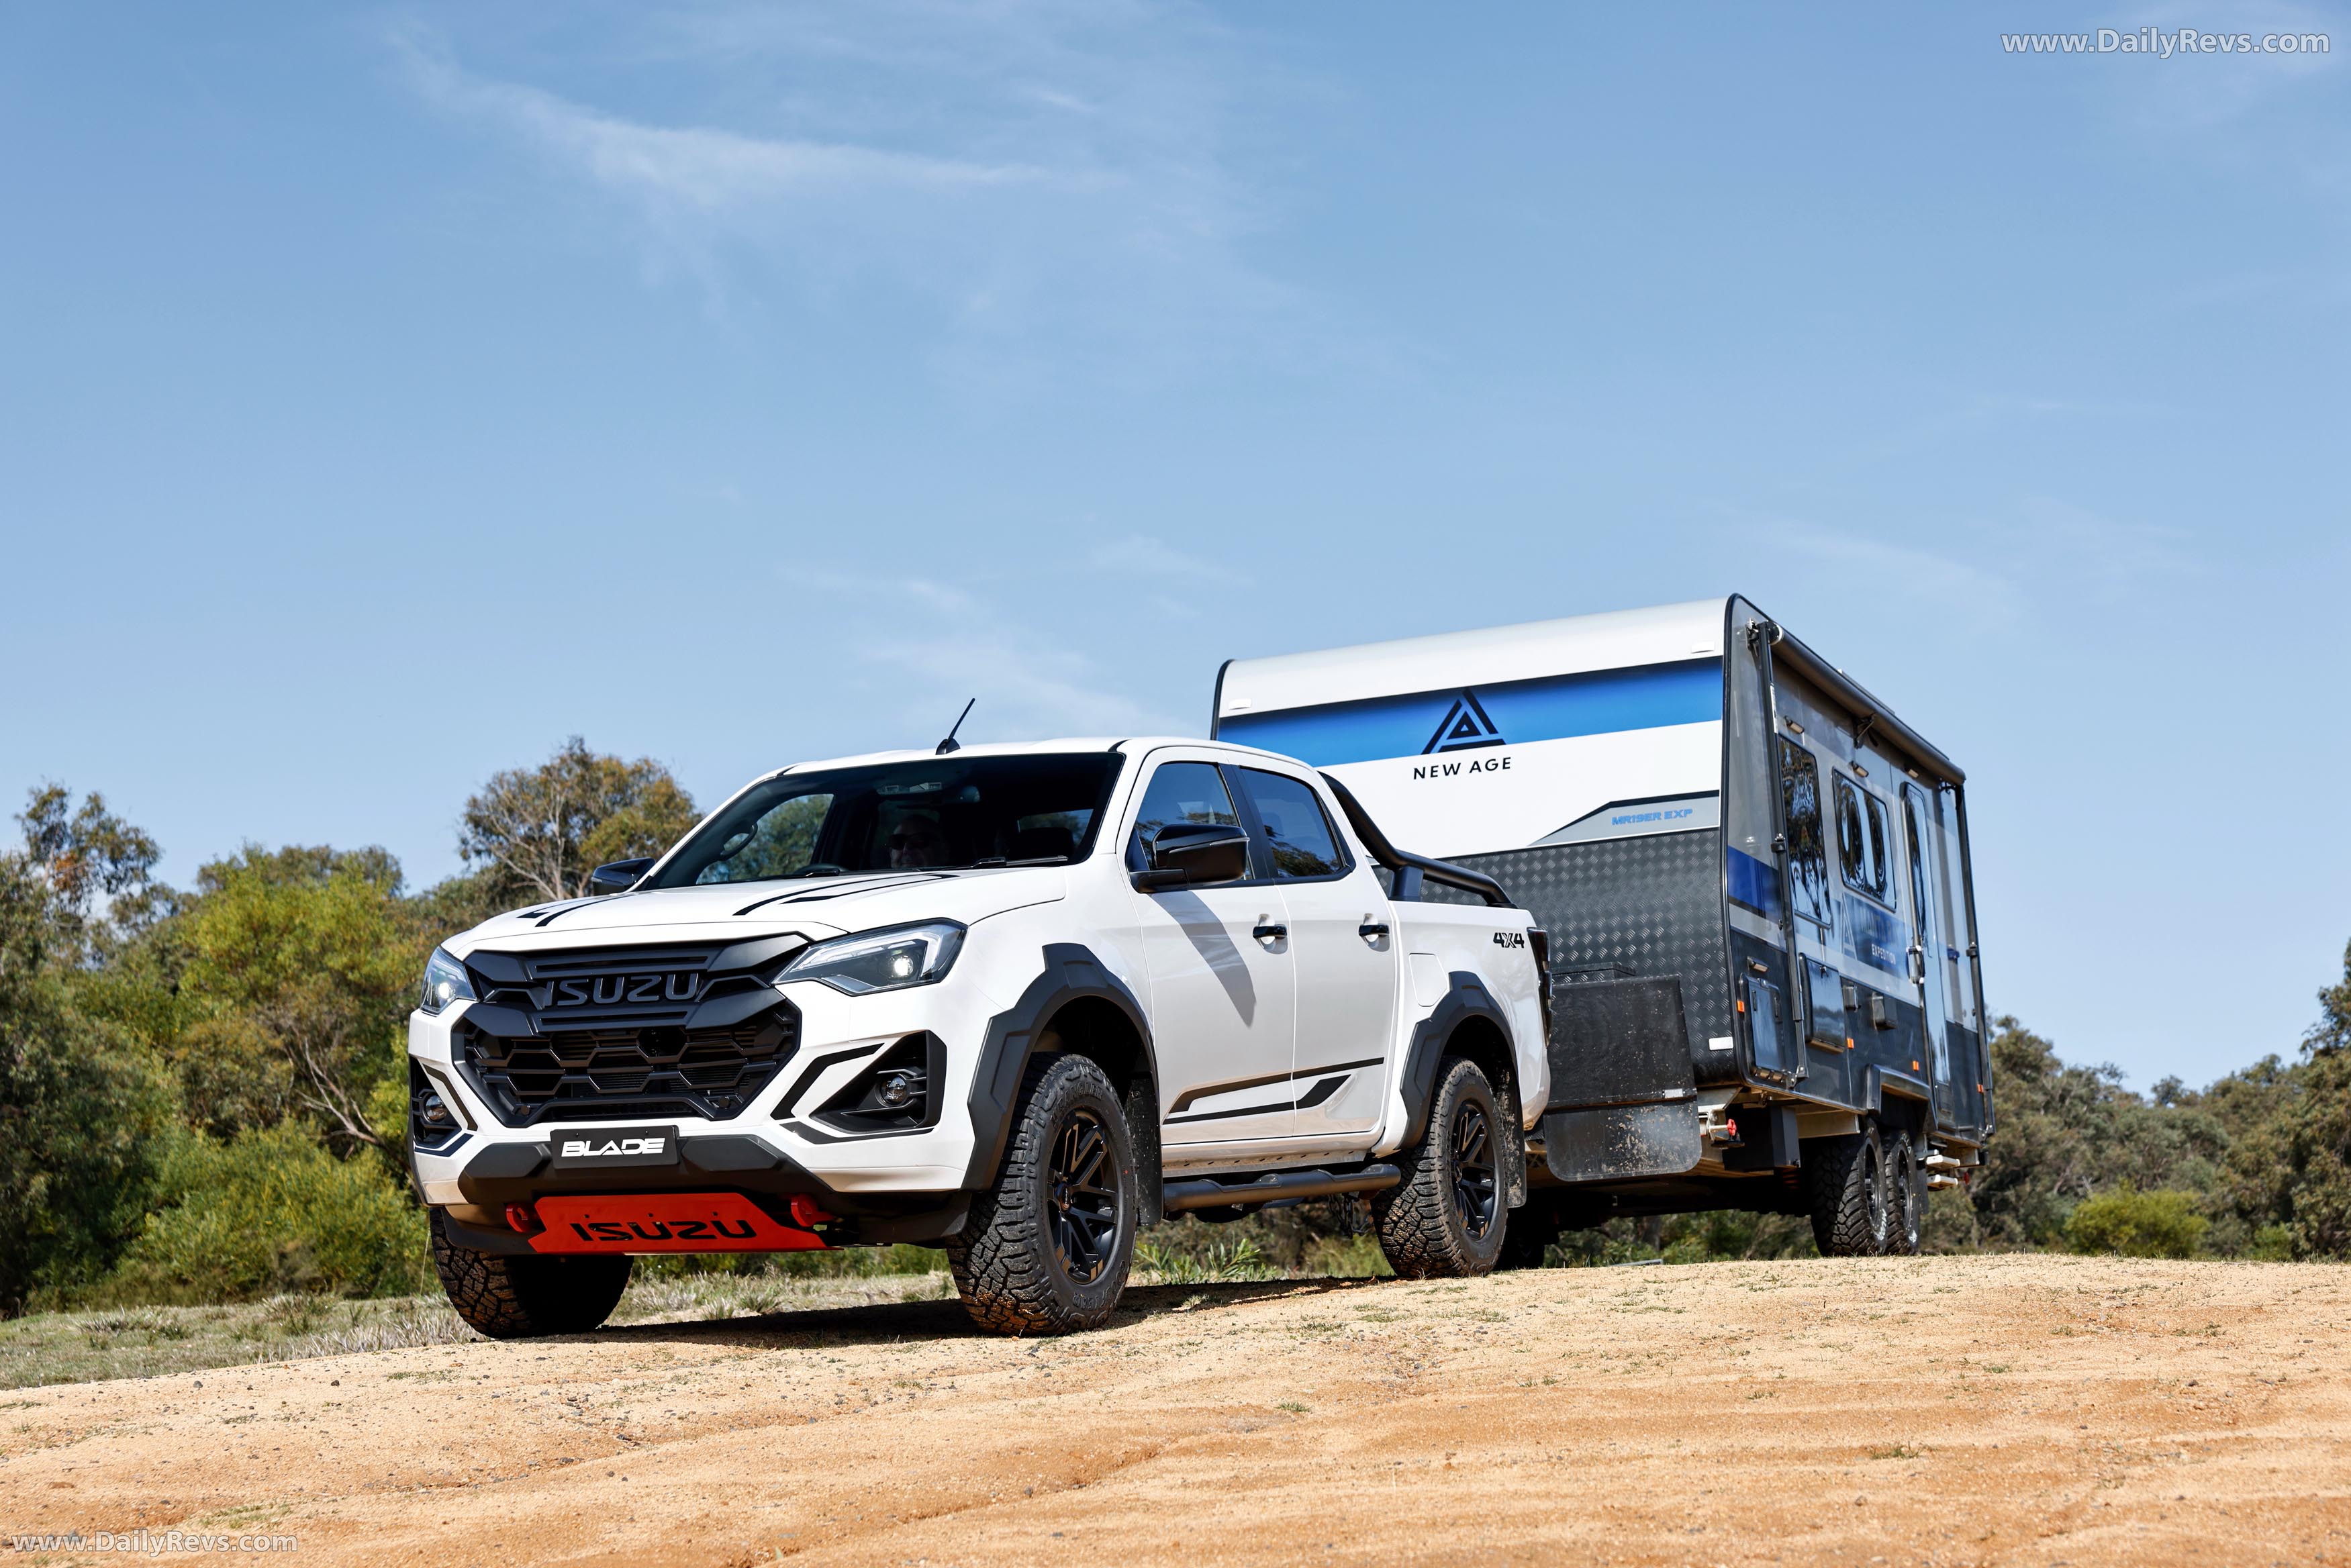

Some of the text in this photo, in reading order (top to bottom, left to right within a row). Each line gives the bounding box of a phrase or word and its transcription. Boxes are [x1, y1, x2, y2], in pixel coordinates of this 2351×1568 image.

[1413, 756, 1511, 780] NEW AGE
[1611, 808, 1693, 825] MR19ER EXP
[1871, 943, 1897, 965] EXPEDITION
[543, 973, 700, 1007] ISUZU
[561, 1138, 666, 1158] BLADE
[569, 1219, 757, 1242] ISUZU
